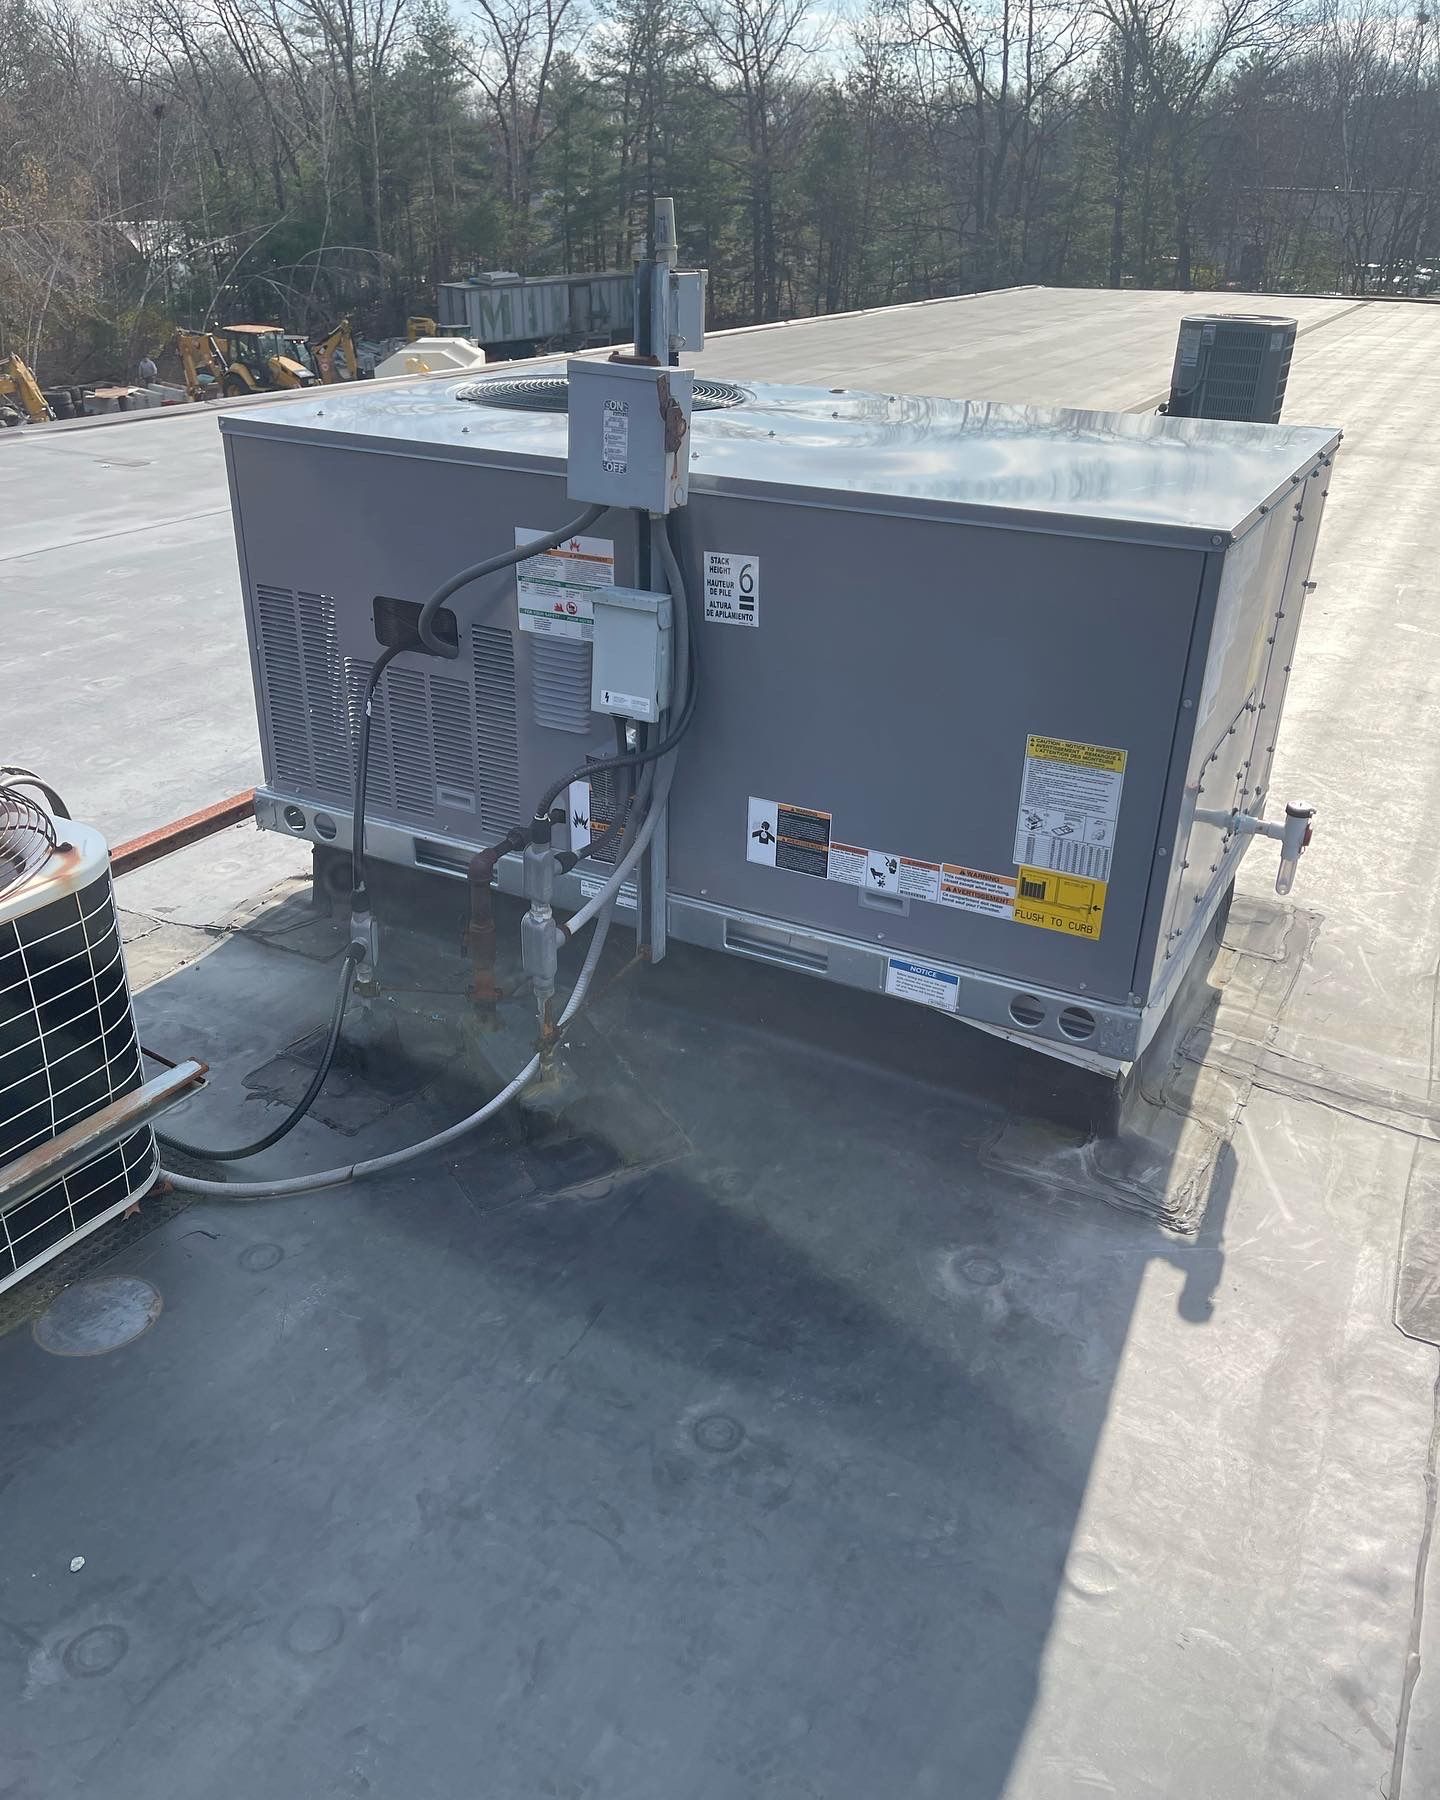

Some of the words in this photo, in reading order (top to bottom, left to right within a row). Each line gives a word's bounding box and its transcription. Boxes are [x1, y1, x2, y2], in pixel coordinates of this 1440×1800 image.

[610, 401, 624, 411] ON
[607, 463, 624, 472] OFF
[711, 557, 729, 565] STACK
[710, 566, 731, 574] HEIGHT
[739, 564, 753, 593] 6
[707, 579, 734, 588] HAUTEUR
[719, 589, 731, 597] PILE
[710, 601, 731, 609] ALTURA
[715, 611, 753, 621] APILAMIENTO
[1036, 738, 1060, 746] CAUTION
[967, 870, 1000, 883] WARNING
[953, 887, 1009, 905] AVERTISSEMENT
[1015, 909, 1044, 923] FLUSH
[1051, 917, 1062, 926] TO
[1069, 921, 1093, 934] CURB
[910, 966, 936, 978] NOTICE
